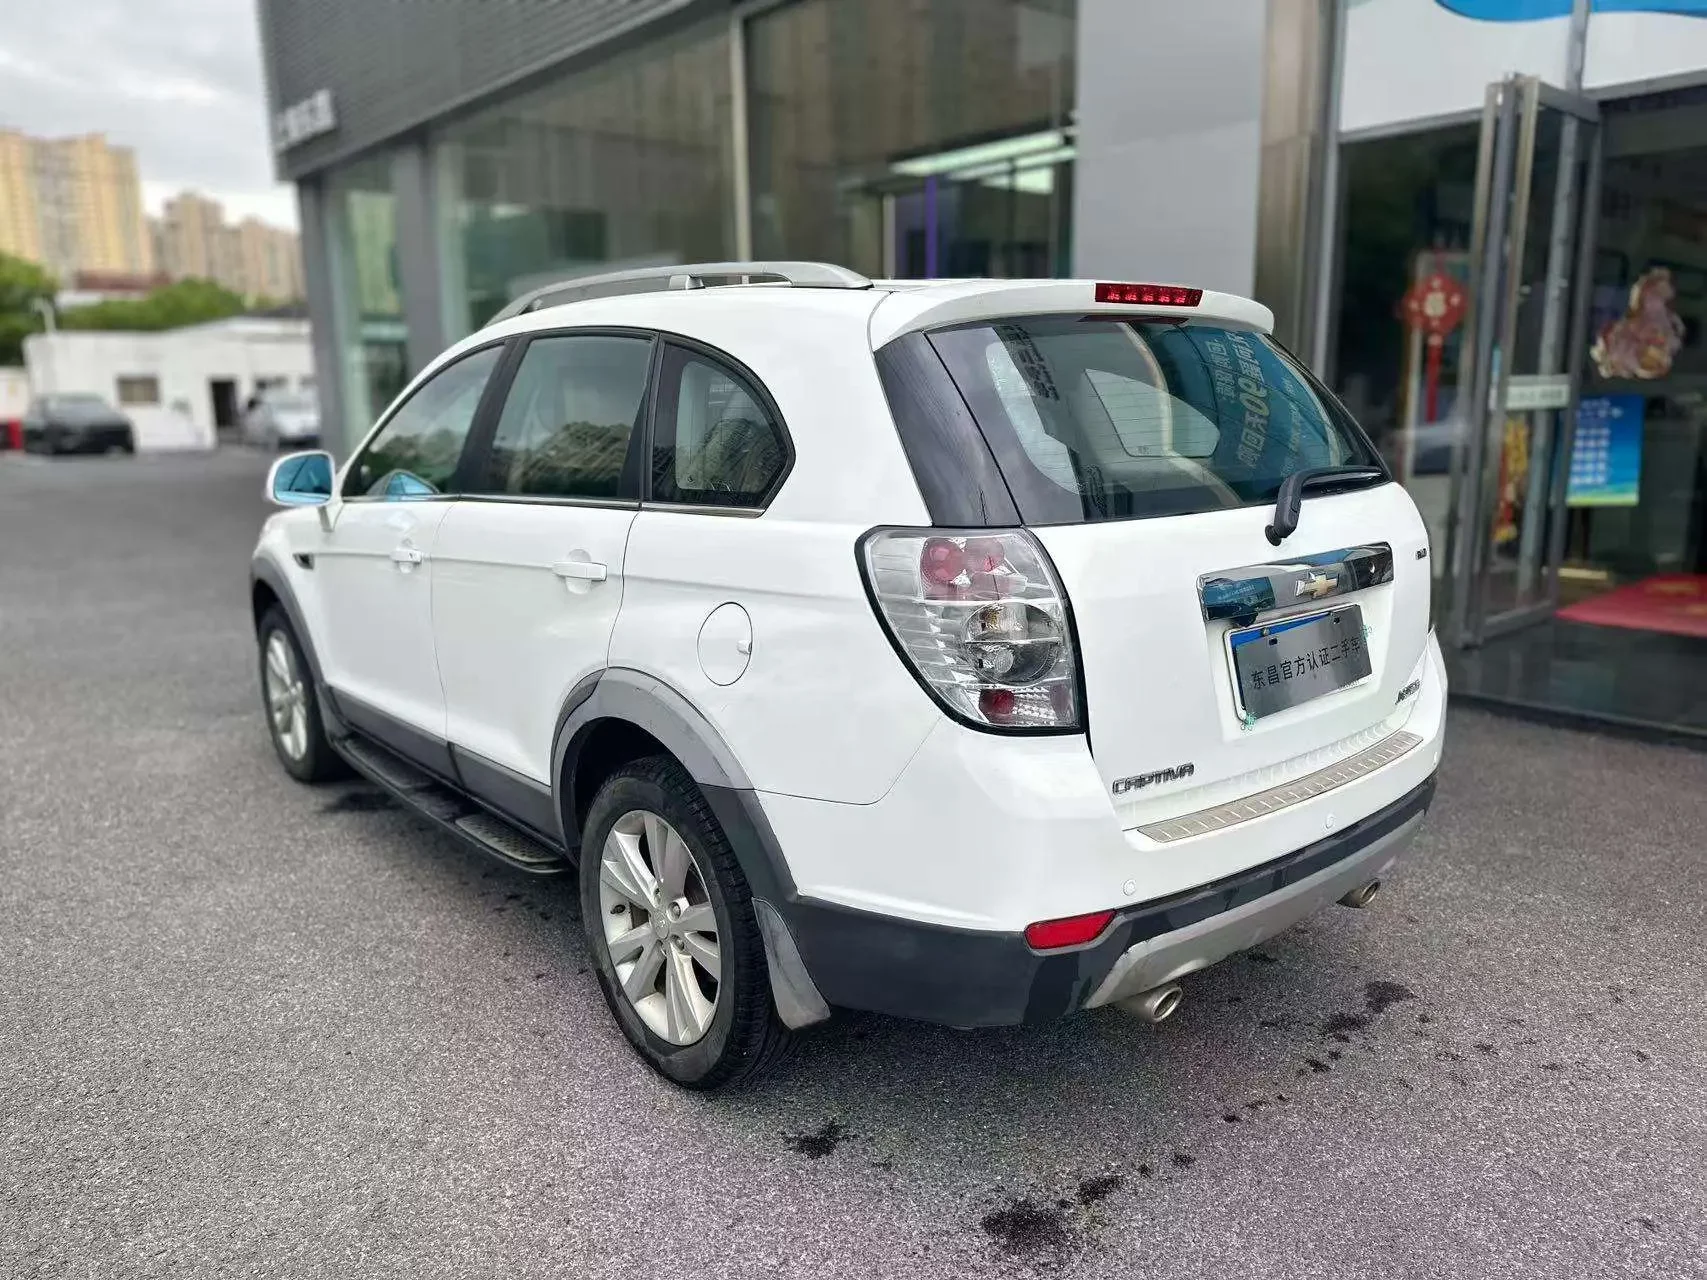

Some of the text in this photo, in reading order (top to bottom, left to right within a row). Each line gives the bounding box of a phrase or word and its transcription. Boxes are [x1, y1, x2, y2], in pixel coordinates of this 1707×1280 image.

[1251, 637, 1361, 690] 东昌官方认证二手车
[1112, 762, 1195, 795] CAPTIVA
